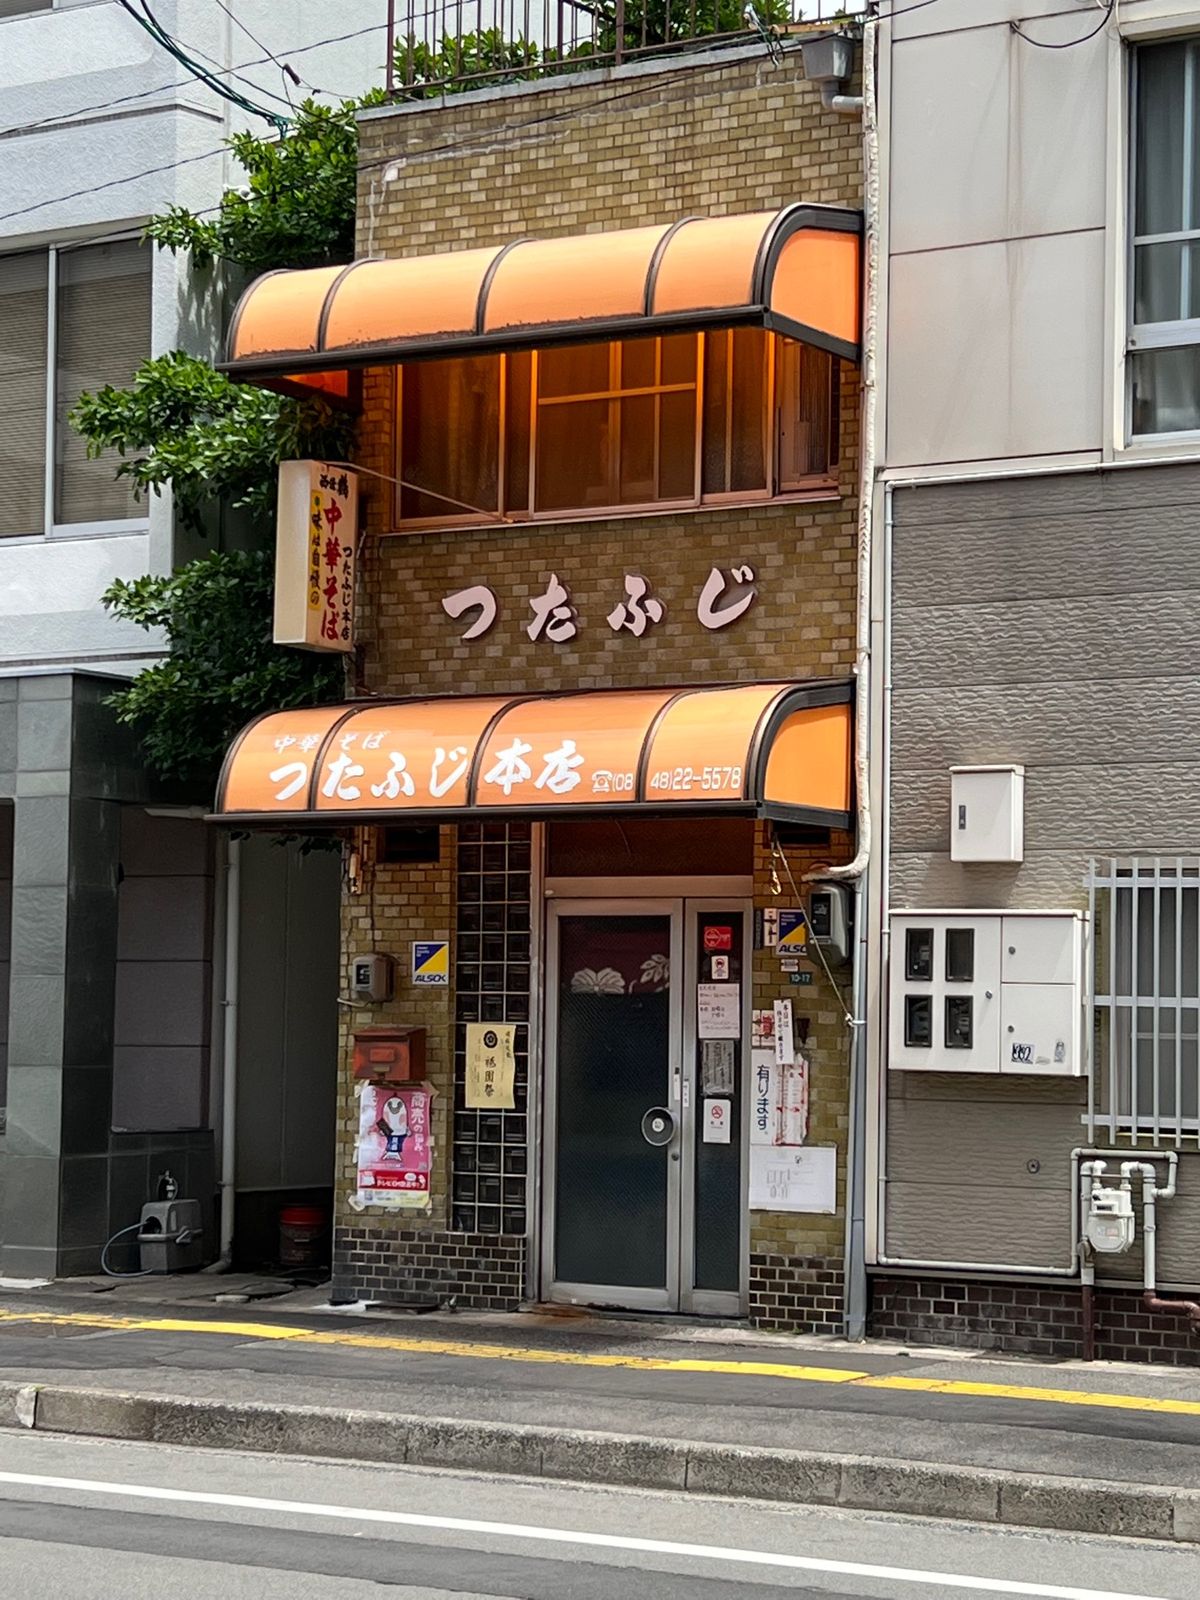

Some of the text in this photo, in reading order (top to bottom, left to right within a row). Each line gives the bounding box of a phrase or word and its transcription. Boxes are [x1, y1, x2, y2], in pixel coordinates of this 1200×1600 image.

[321, 498, 342, 641] 中華そば
[340, 546, 353, 641] つたふじ本店
[441, 563, 756, 644] つたふじ
[268, 738, 585, 801] つたふじ本店
[274, 729, 389, 754] 中華そば
[612, 766, 742, 793] (0848)22-5578
[414, 974, 447, 983] ALSOK
[778, 944, 807, 954] ALSO
[756, 1063, 771, 1131] 有ります
